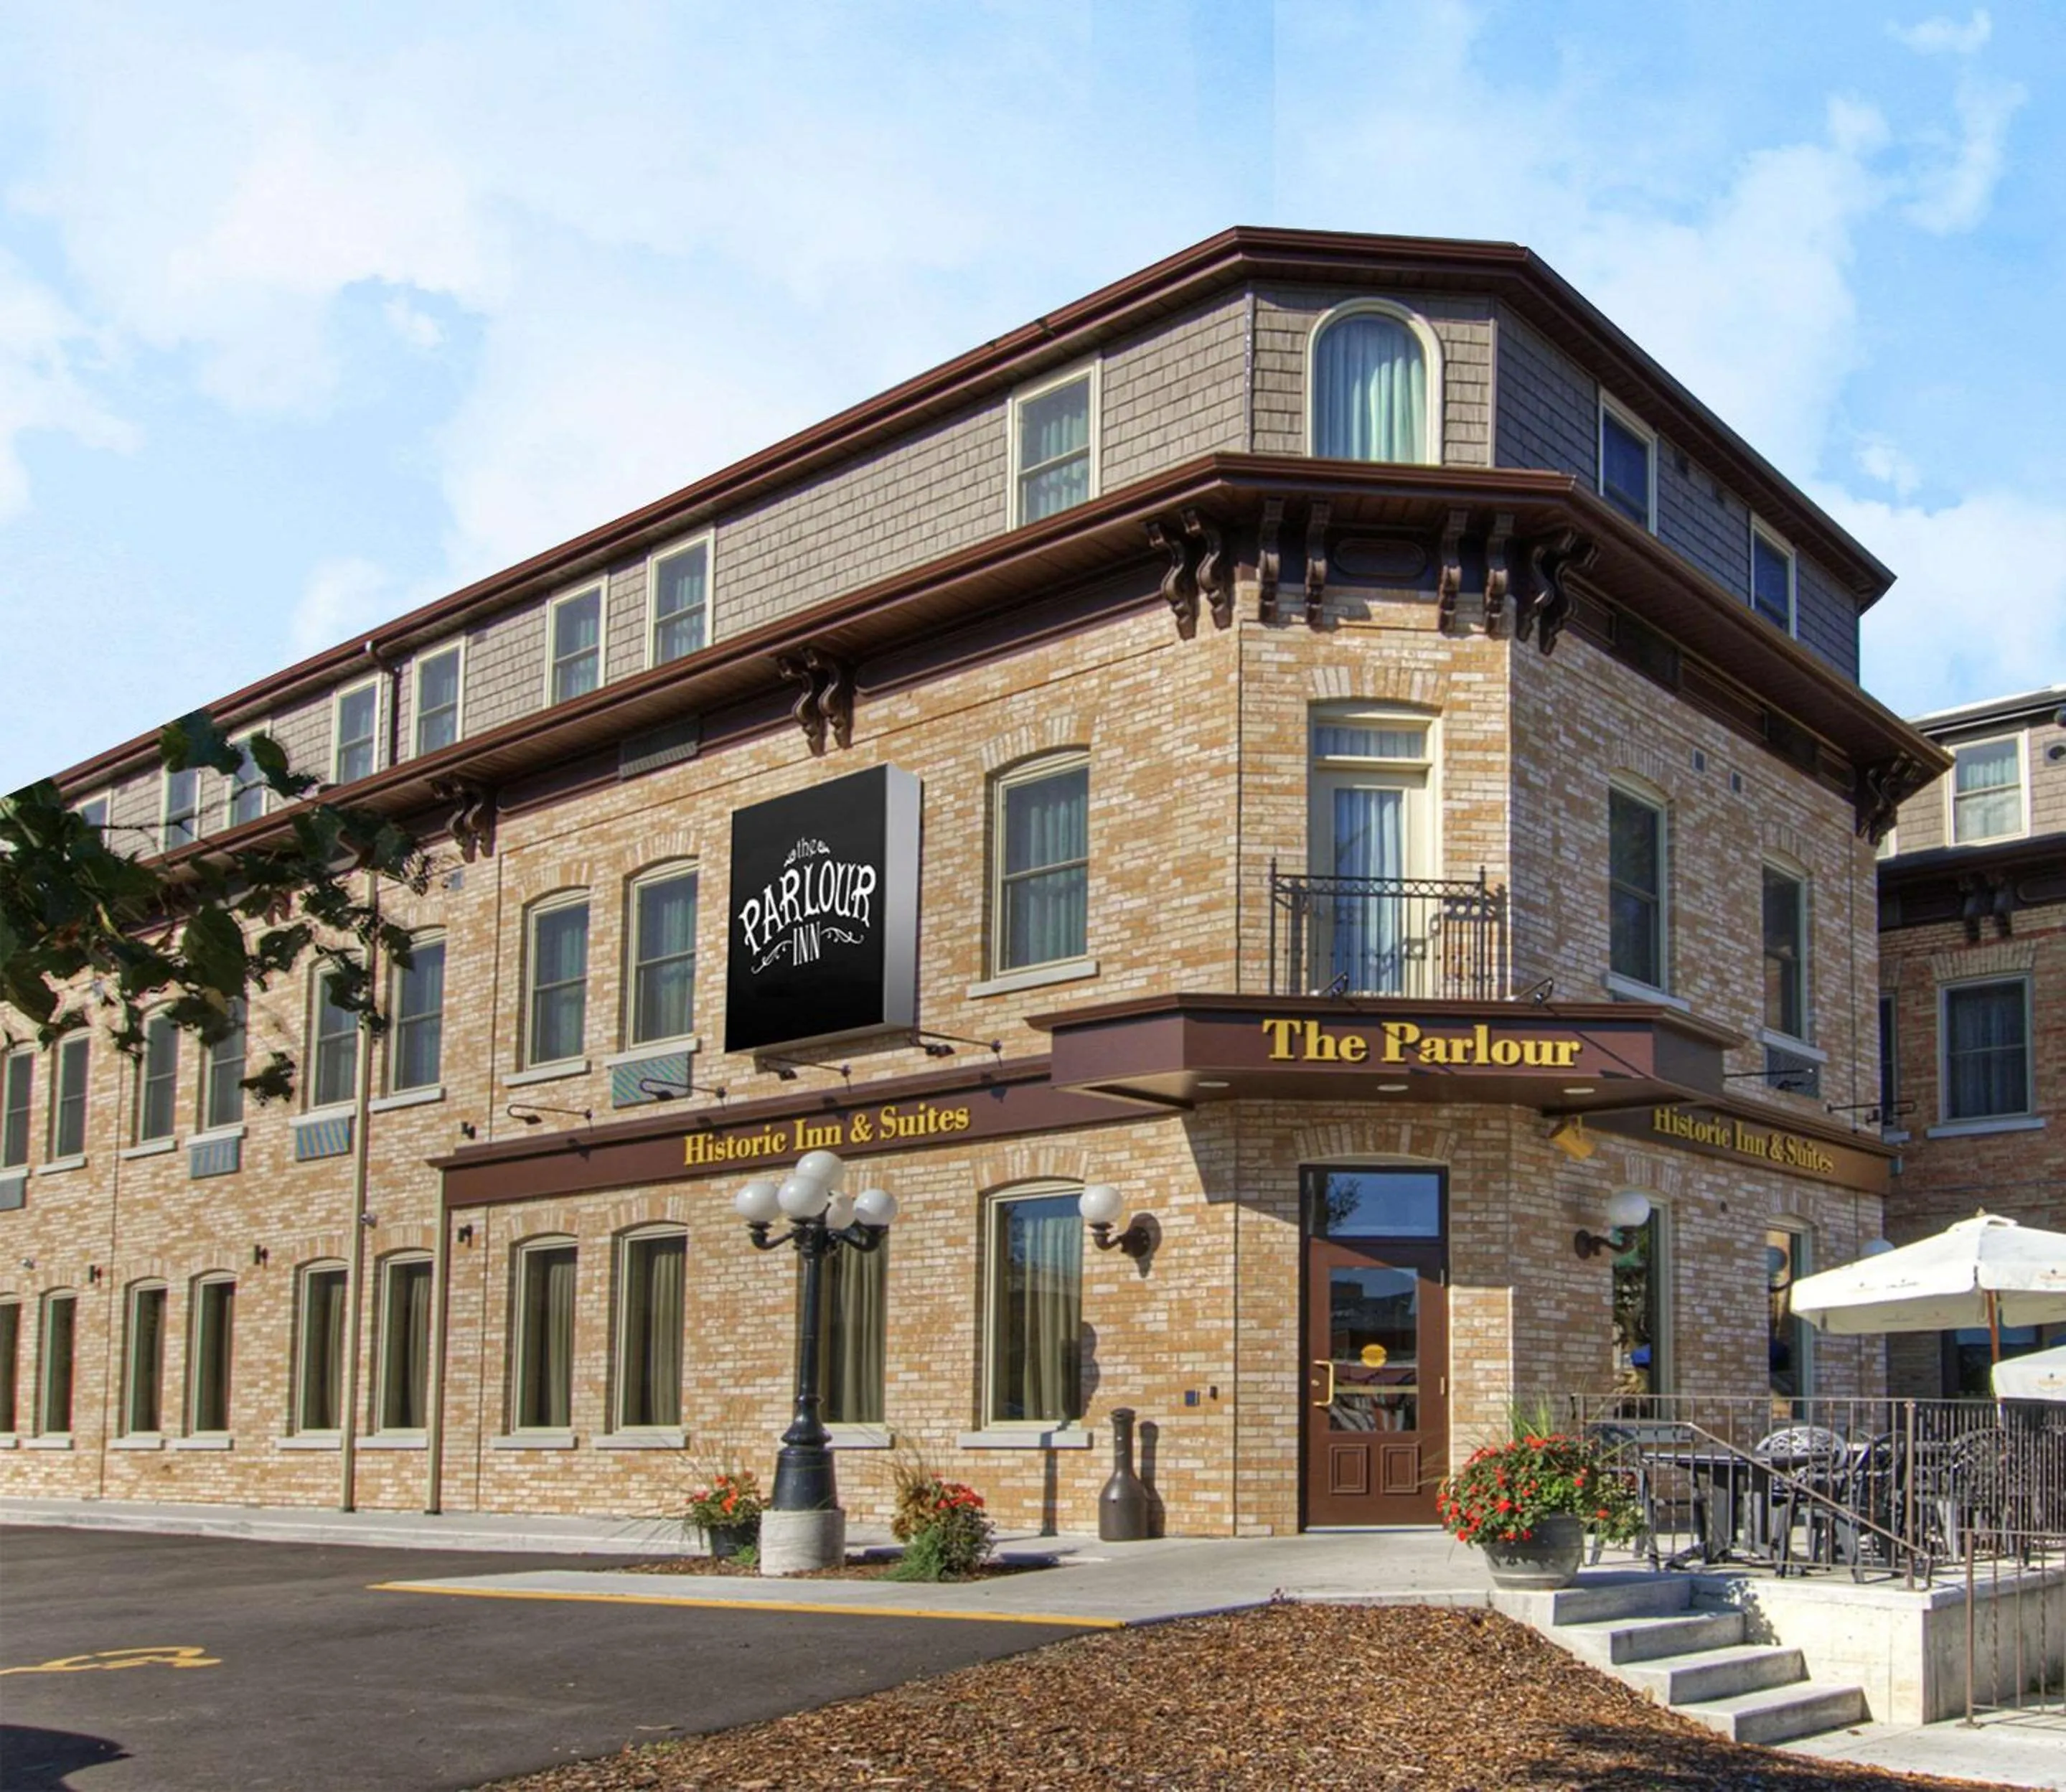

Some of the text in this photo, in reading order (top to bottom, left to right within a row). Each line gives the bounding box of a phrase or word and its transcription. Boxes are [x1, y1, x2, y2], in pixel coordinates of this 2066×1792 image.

[797, 837, 817, 858] the
[738, 860, 876, 955] PARLOUR
[792, 921, 820, 966] INN
[1262, 1018, 1582, 1067] The Parlour
[684, 1102, 970, 1165] Historic Inn & Suites
[1654, 1107, 1834, 1173] Historic Inn & Suites
